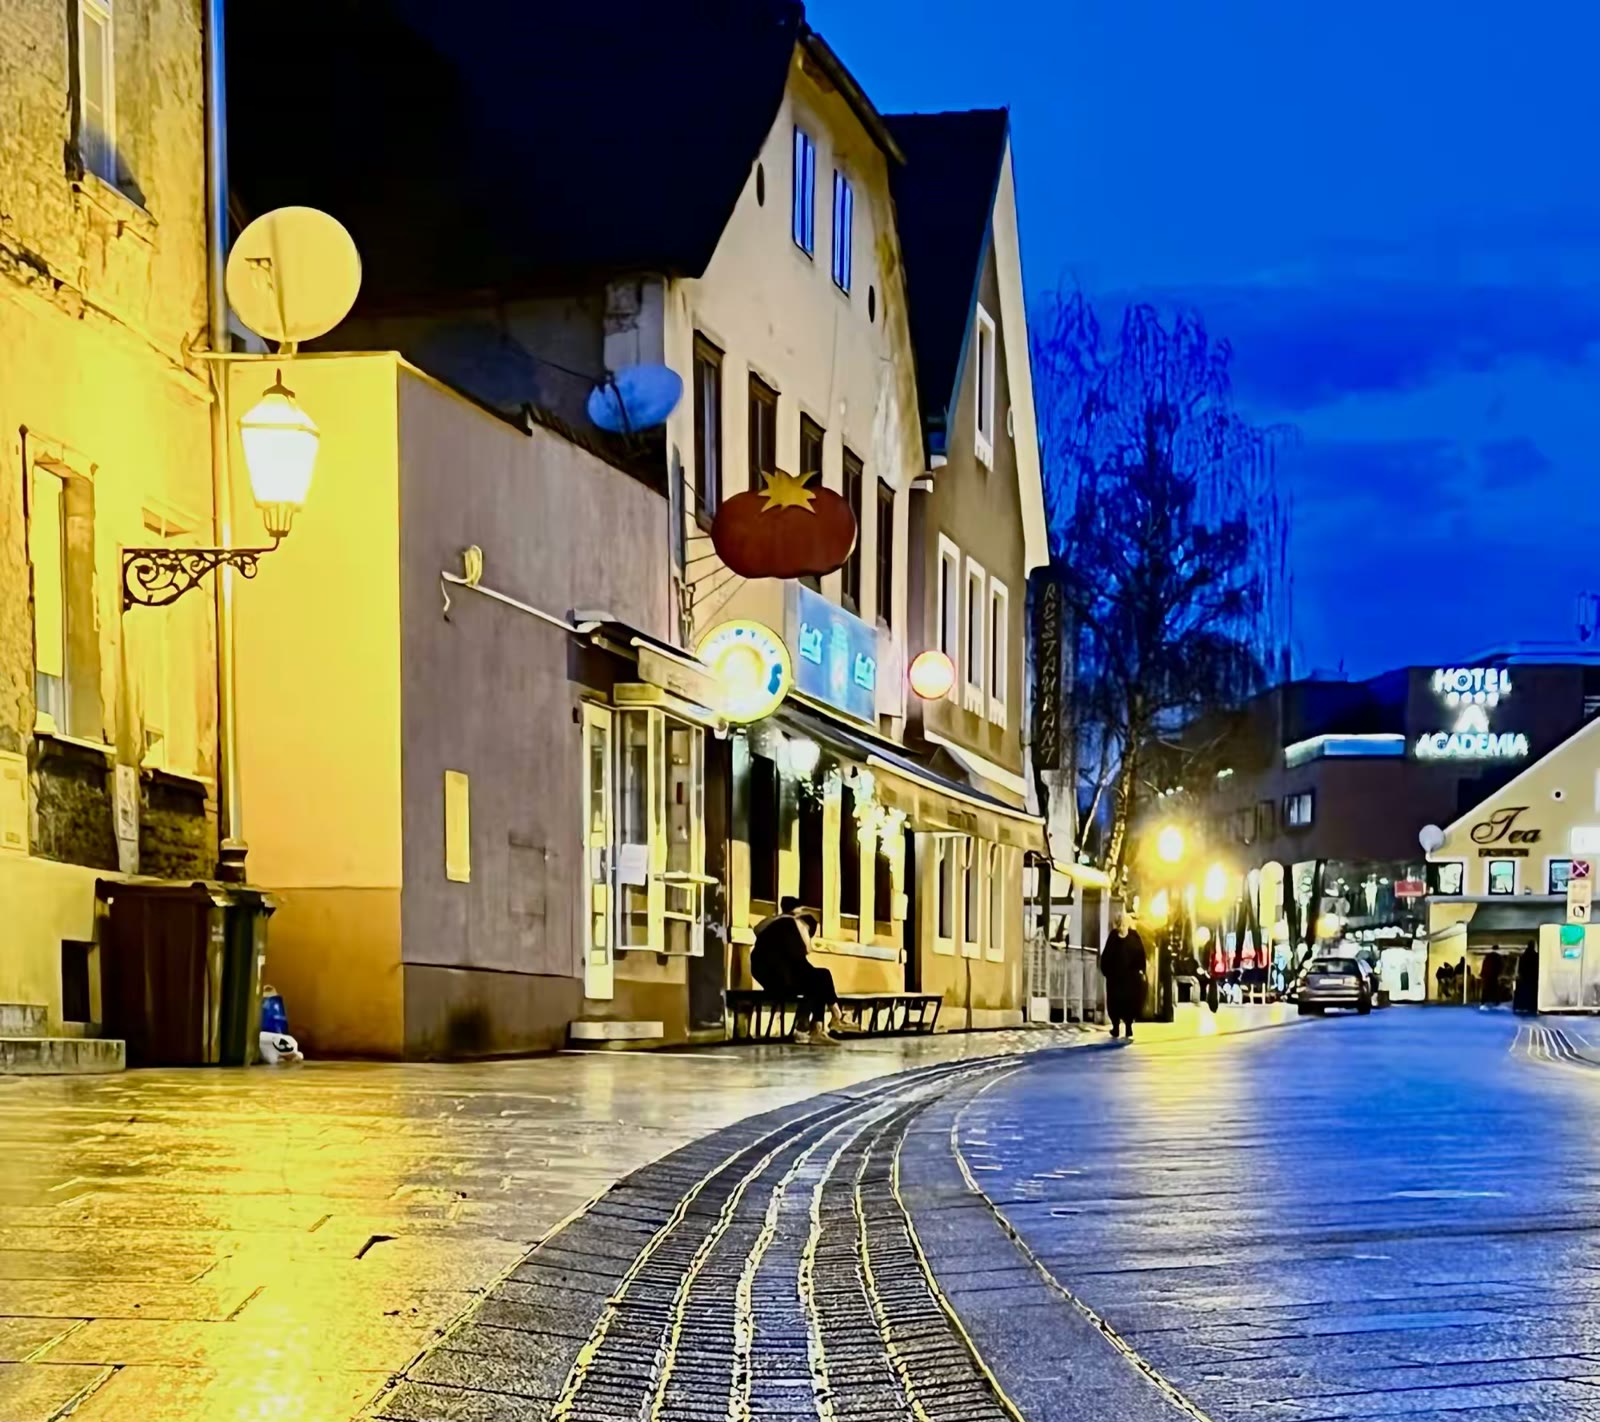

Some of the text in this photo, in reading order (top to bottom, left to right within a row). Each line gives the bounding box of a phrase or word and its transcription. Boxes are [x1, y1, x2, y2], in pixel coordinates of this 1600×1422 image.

[1040, 582, 1057, 764] RESTAURANT
[1433, 668, 1512, 694] HOTEL
[1415, 733, 1528, 758] ACADEMIA
[1470, 806, 1541, 844] Tea
